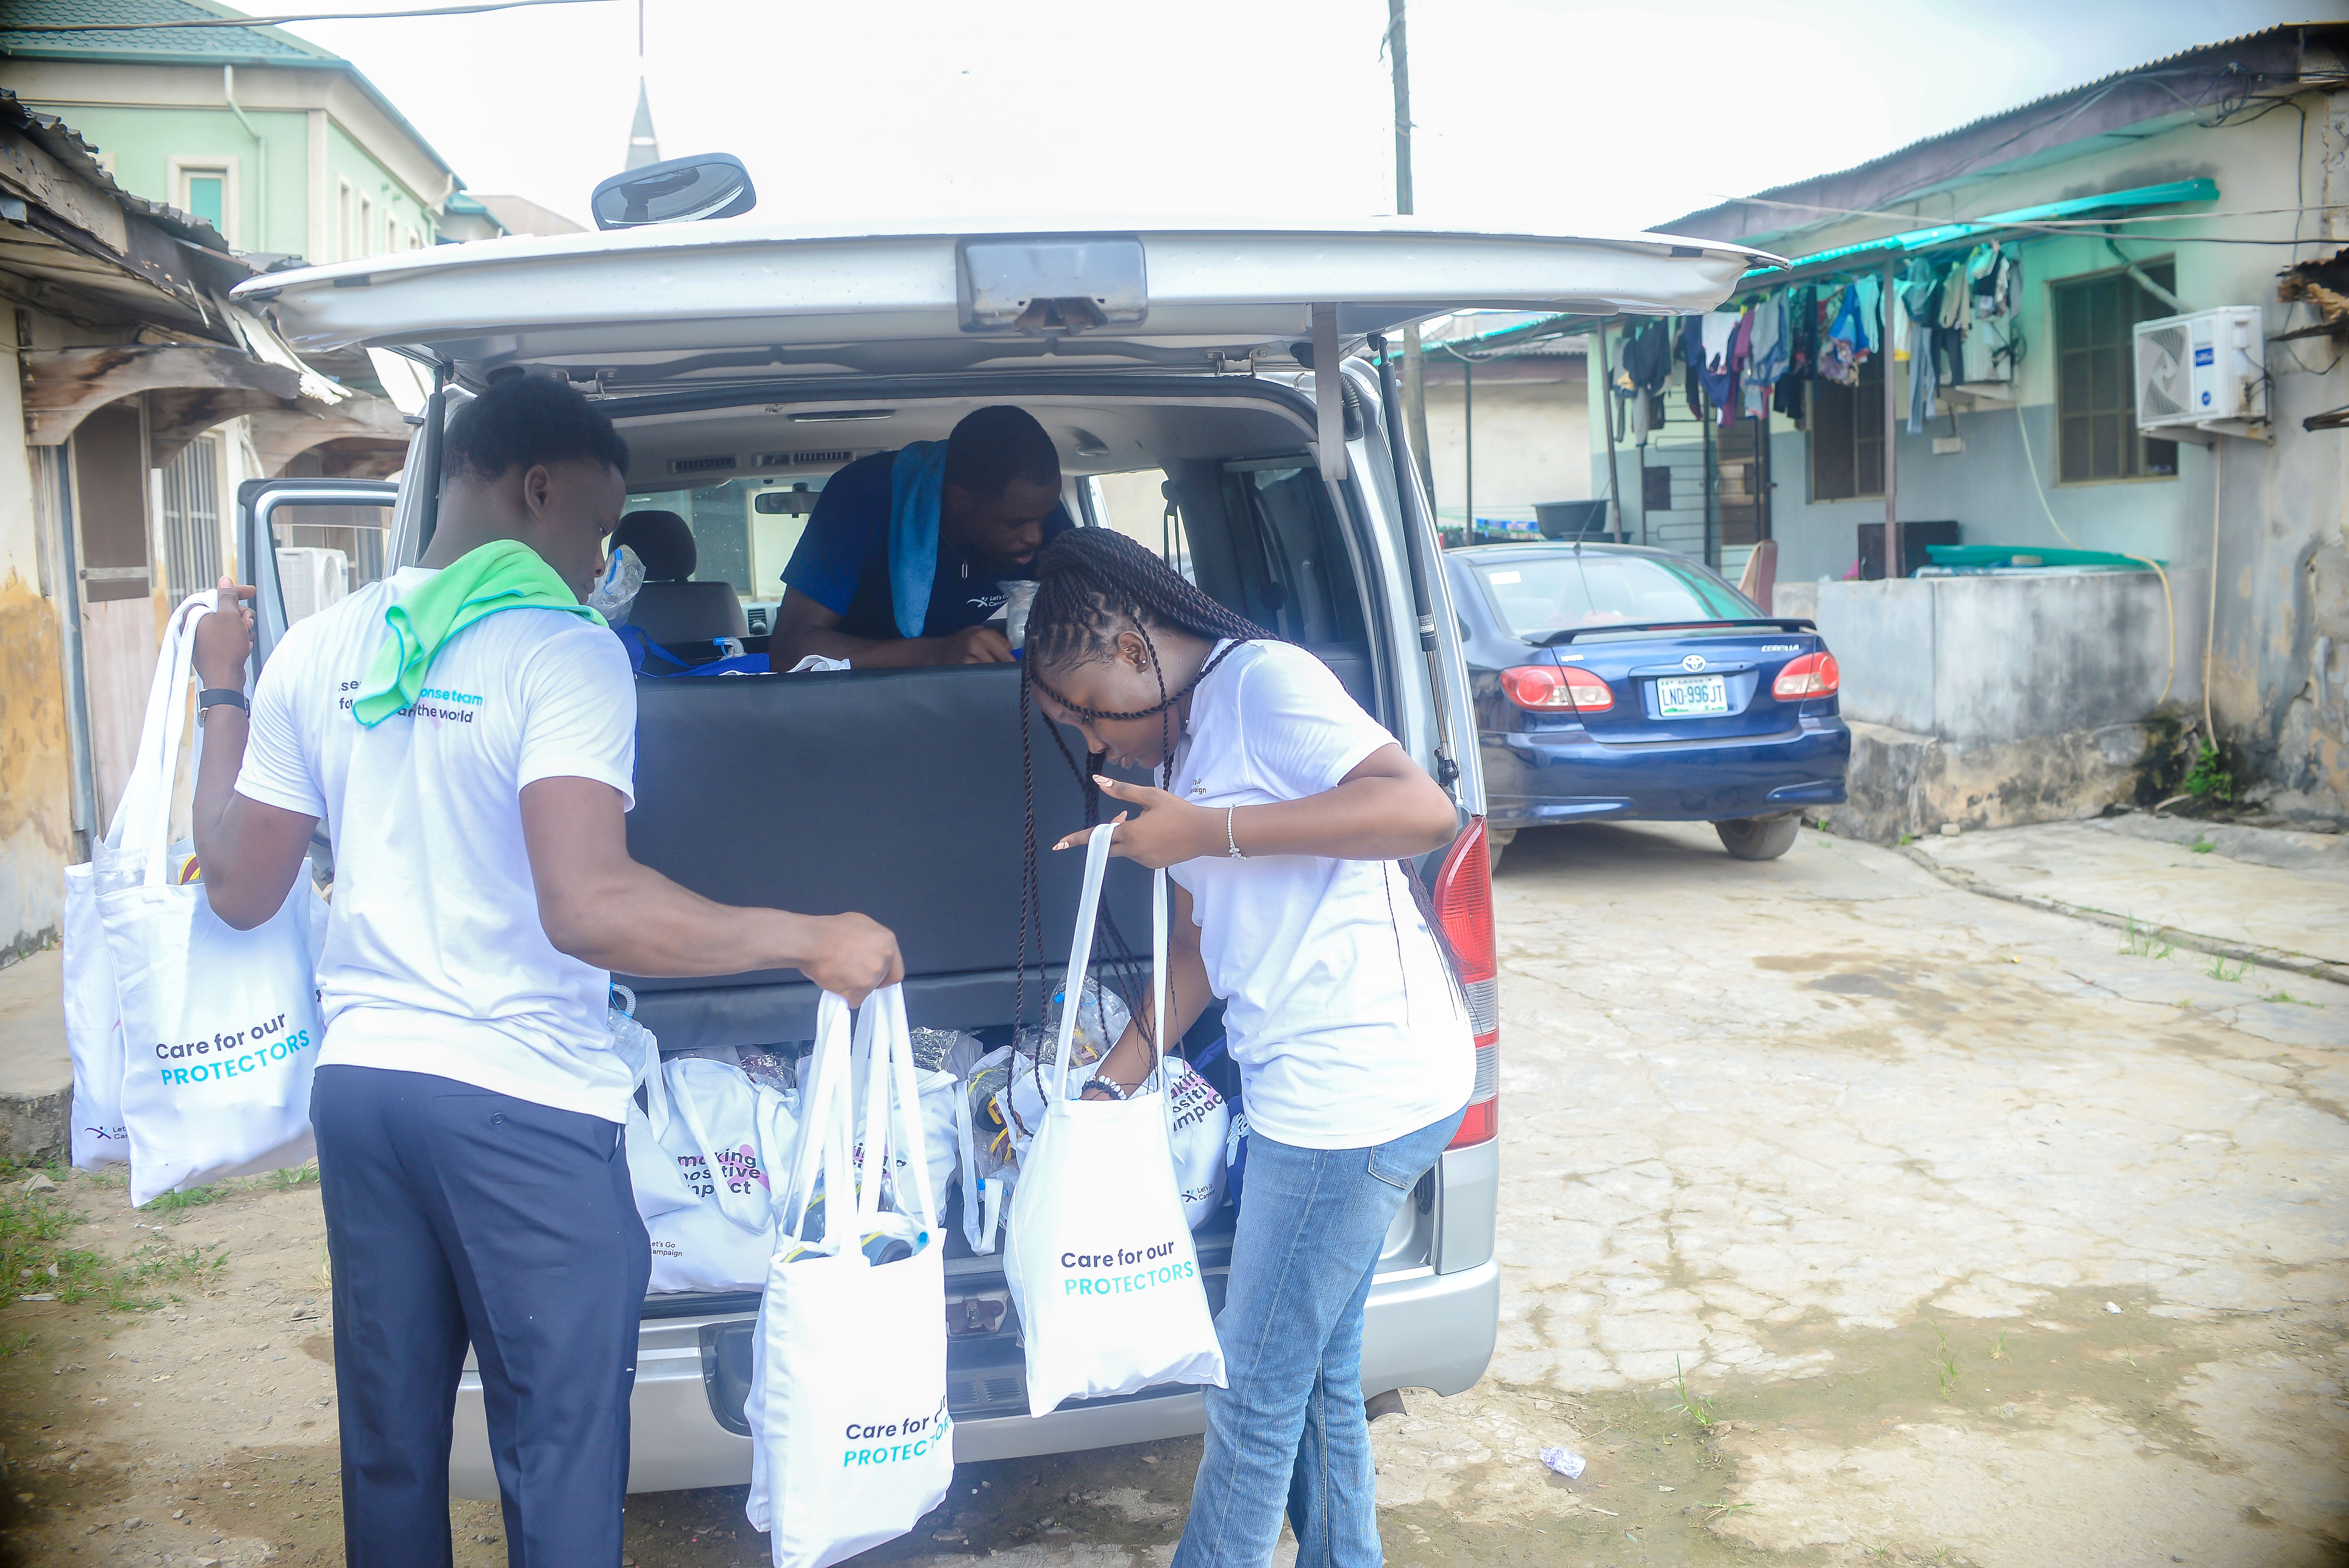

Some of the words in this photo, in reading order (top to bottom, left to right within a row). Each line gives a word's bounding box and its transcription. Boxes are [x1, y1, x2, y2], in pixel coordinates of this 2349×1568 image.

[451, 690, 483, 706] team
[418, 704, 437, 717] the
[439, 709, 474, 723] world
[156, 1043, 209, 1059] Care
[214, 1033, 245, 1051] for
[251, 1013, 285, 1039] our
[161, 1030, 310, 1085] PROTECTORS
[1173, 1093, 1223, 1132] impac
[652, 1249, 683, 1258] ampaign
[1061, 1253, 1113, 1268] Care
[1117, 1249, 1142, 1265] for
[1147, 1241, 1174, 1260] our
[1064, 1261, 1194, 1295] PROTECTORS
[846, 1424, 897, 1440] Care
[902, 1416, 930, 1436] for
